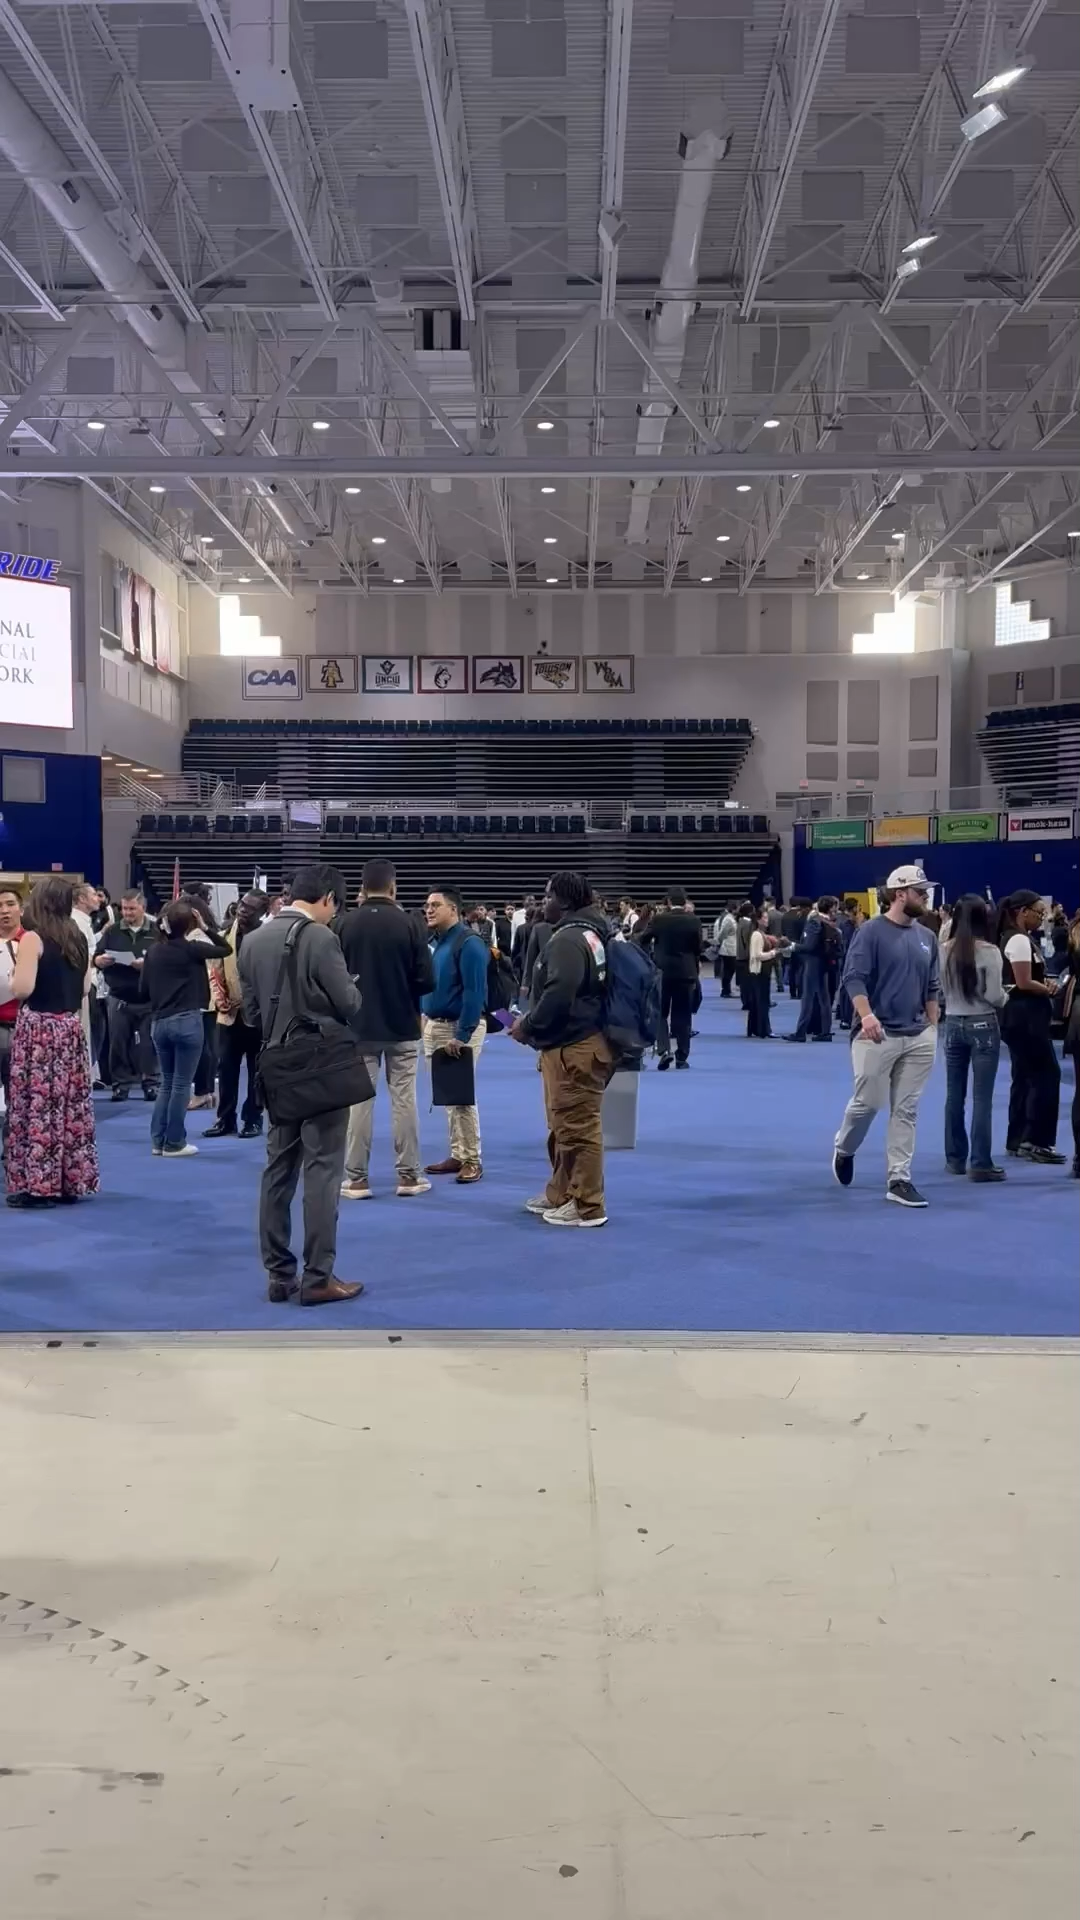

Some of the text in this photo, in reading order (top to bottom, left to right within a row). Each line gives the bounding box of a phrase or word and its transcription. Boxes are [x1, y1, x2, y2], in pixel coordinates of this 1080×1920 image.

[0, 551, 62, 581] RIDE
[0, 620, 35, 639] NAL
[247, 669, 297, 686] CAA
[534, 661, 572, 676] TOWSON
